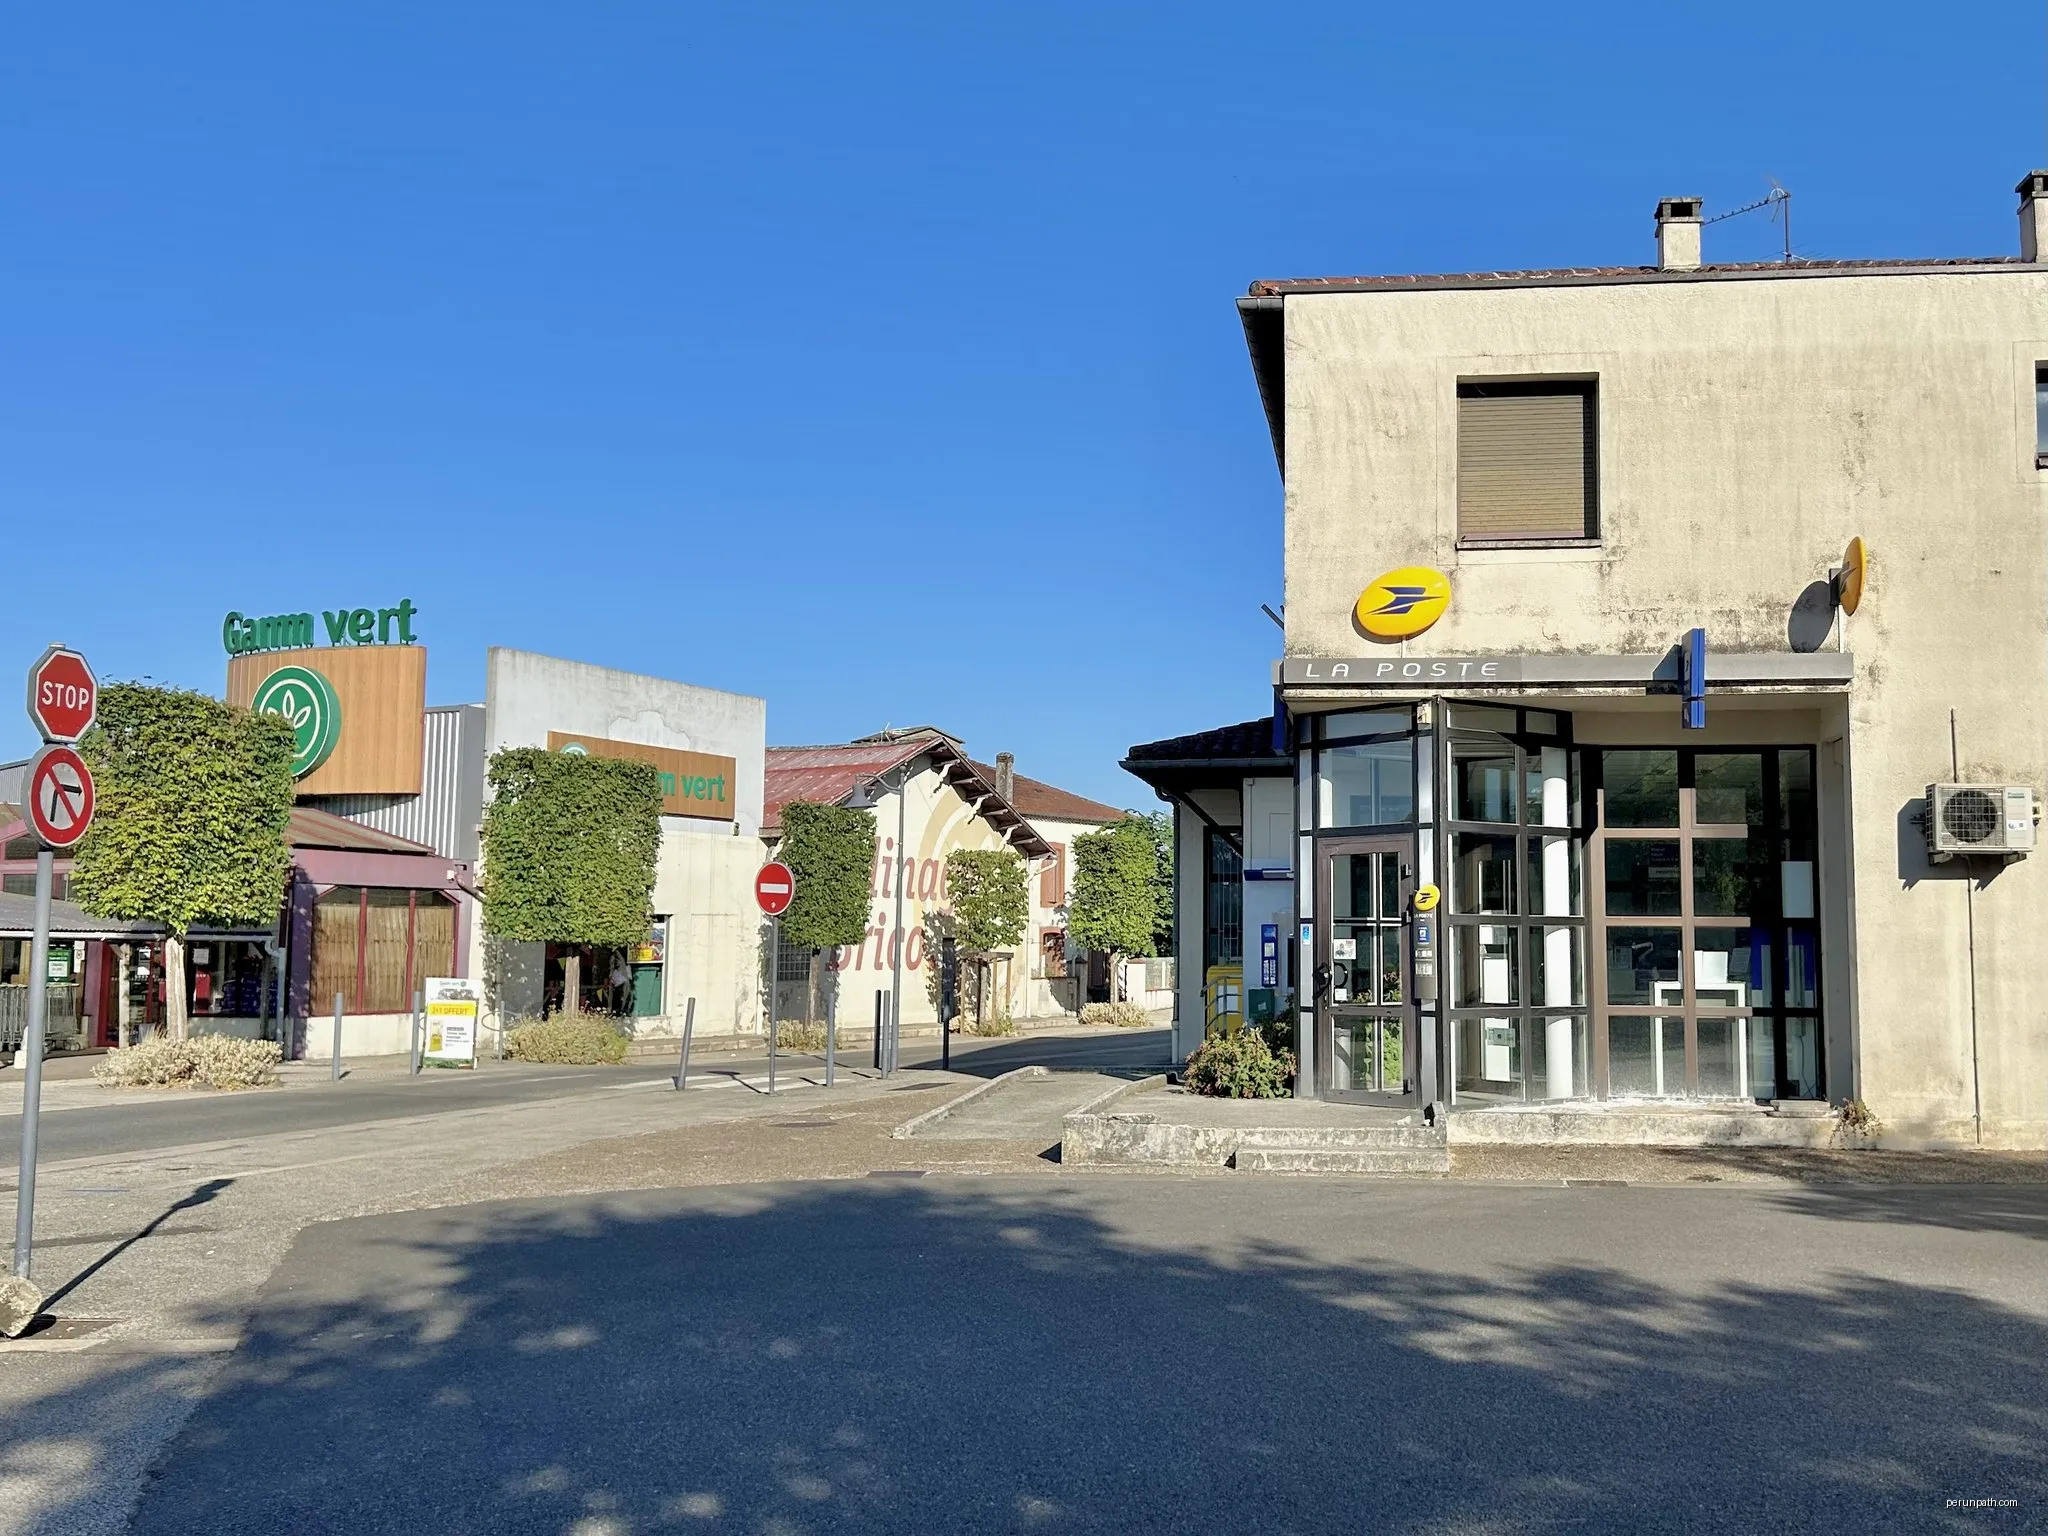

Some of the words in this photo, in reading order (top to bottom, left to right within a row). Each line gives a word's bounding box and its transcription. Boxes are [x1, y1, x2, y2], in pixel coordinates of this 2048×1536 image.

[223, 610, 314, 655] Gamm
[322, 598, 417, 643] vert
[1305, 663, 1350, 678] LA
[1376, 662, 1499, 678] POSTE
[42, 680, 90, 711] STOP
[681, 773, 725, 802] vert
